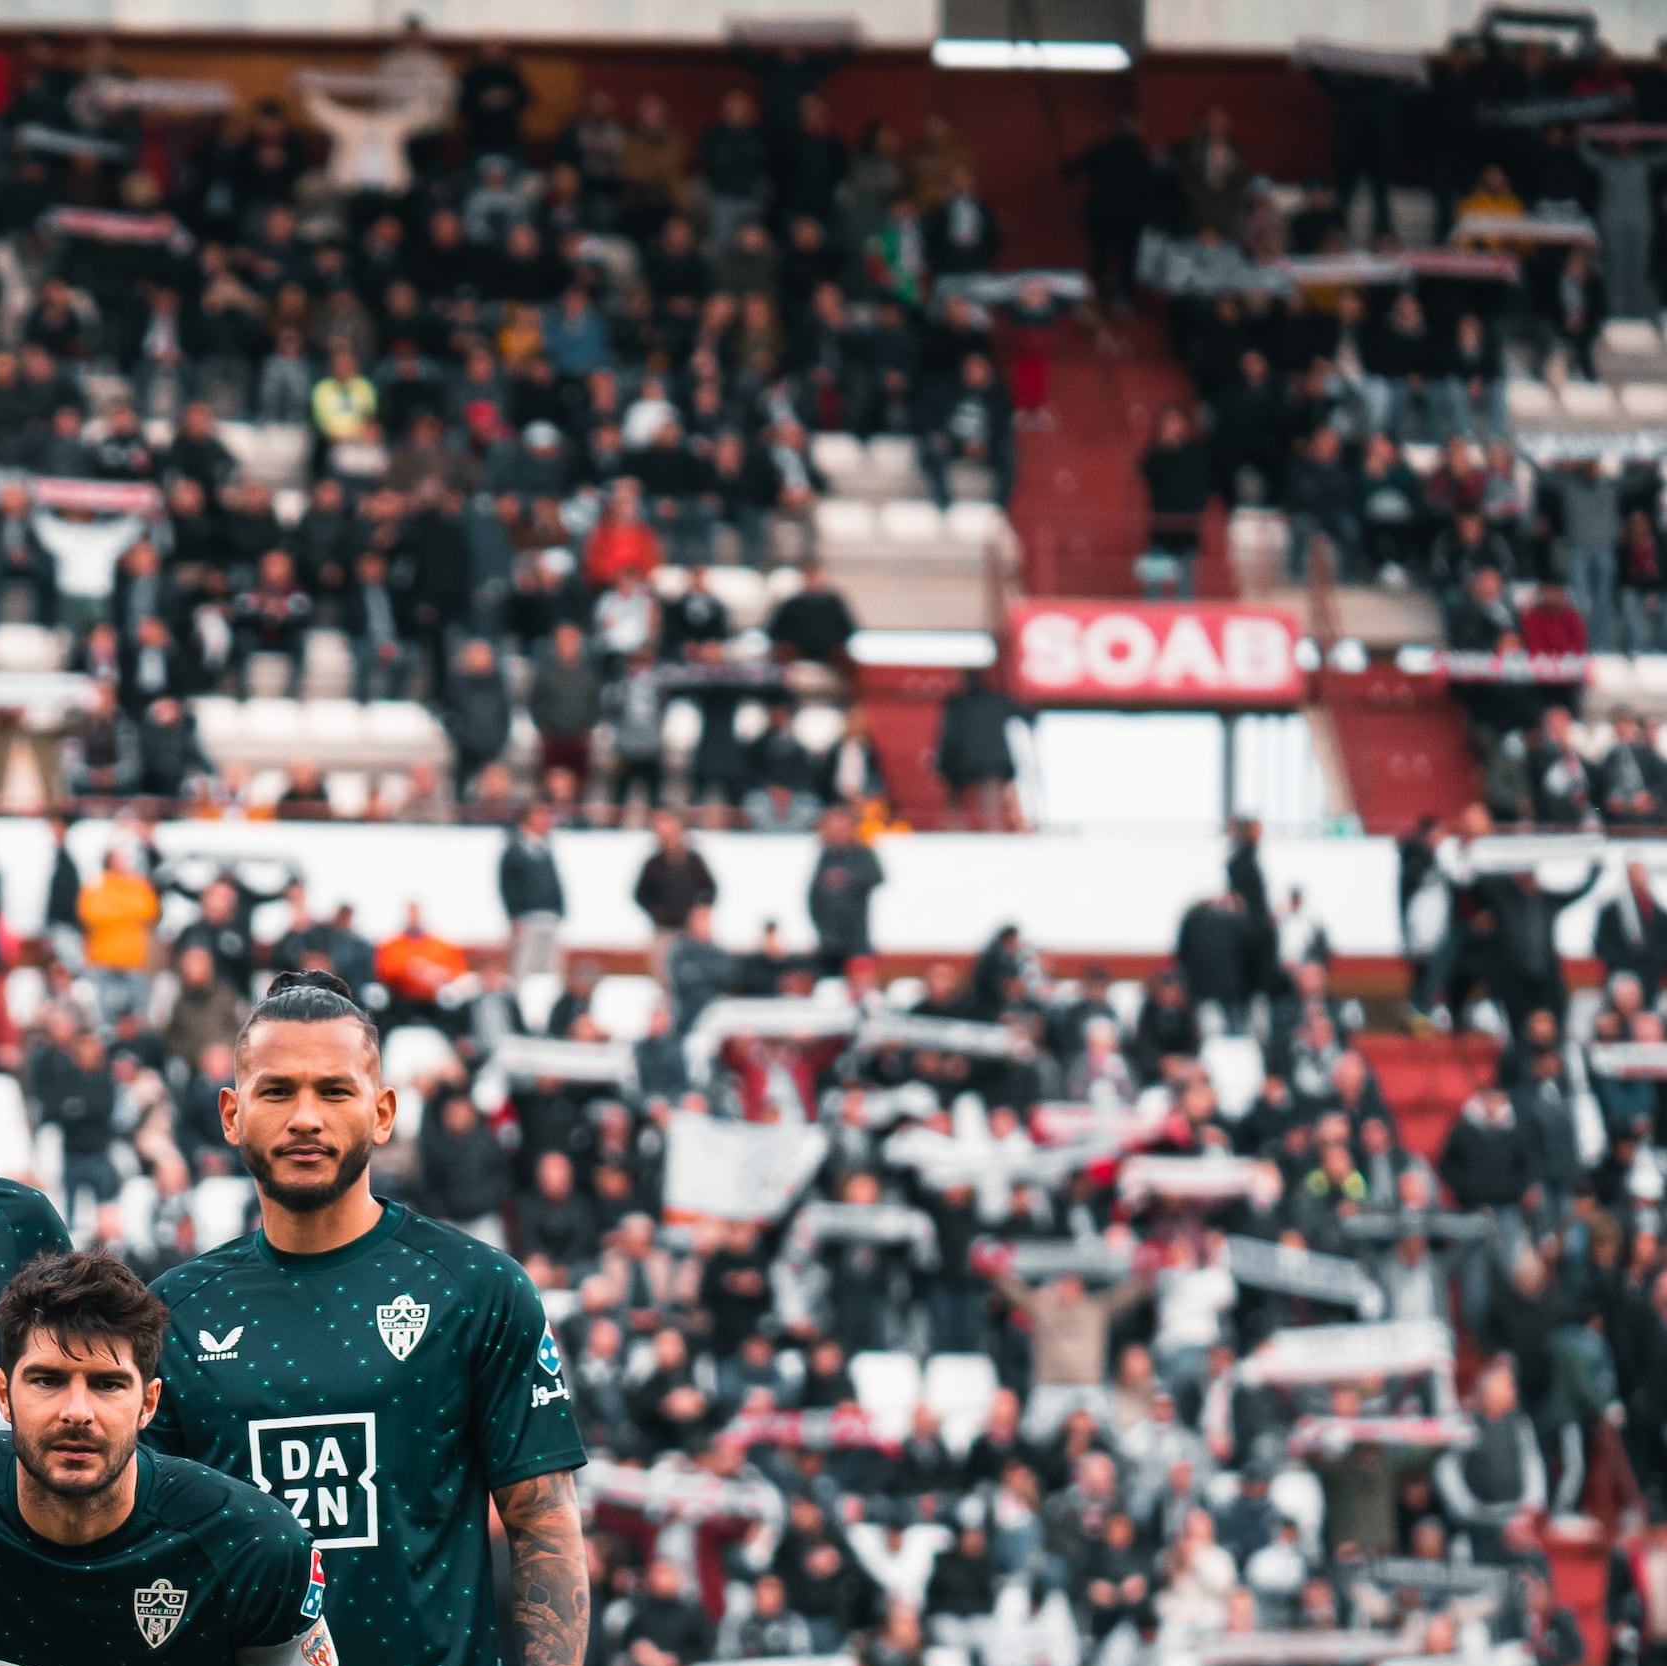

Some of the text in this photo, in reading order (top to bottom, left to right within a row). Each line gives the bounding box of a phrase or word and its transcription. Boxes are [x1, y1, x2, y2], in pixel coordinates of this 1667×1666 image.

[1022, 616, 1288, 689] SOAB
[383, 1321, 421, 1329] ALMERIA
[197, 1352, 238, 1361] CASTORE
[280, 1436, 349, 1480] DA
[289, 1486, 349, 1527] ZN
[138, 1607, 179, 1615] ALMERIA
